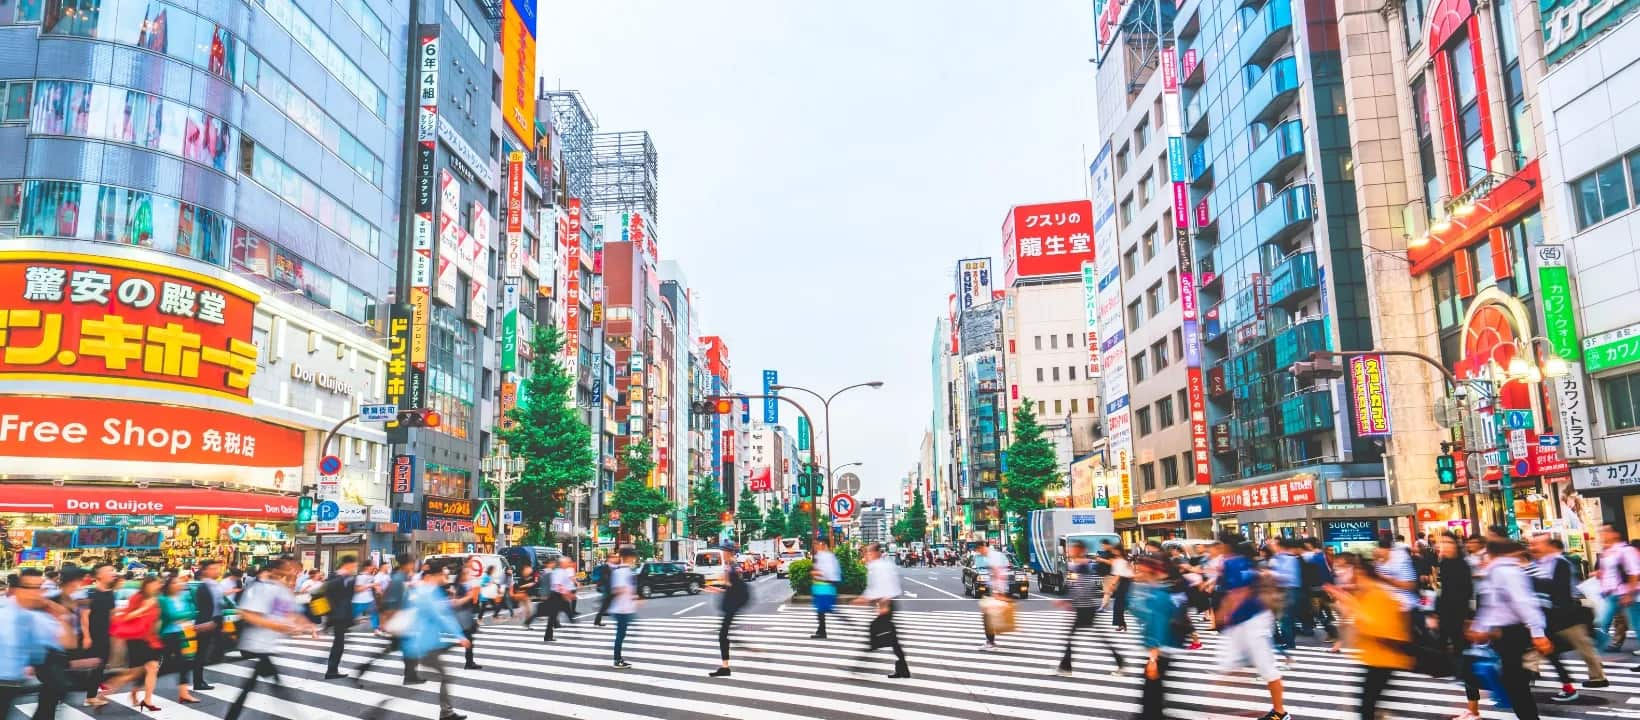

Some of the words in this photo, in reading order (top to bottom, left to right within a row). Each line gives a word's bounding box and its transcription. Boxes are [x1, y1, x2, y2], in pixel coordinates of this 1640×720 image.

[422, 44, 436, 100] 6年4組
[421, 150, 430, 205] ザ・ロックアップ
[570, 207, 579, 255] カラオケ
[1025, 212, 1081, 228] クスリの
[1020, 233, 1091, 257] 龍生堂
[24, 267, 226, 325] 驚安の殿堂
[568, 270, 577, 317] パセラ
[505, 328, 514, 352] レイク
[1551, 285, 1571, 358] カワノ・クォーク
[319, 372, 353, 394] Quijote
[1, 415, 88, 443] Free
[102, 418, 191, 453] Shop
[202, 429, 255, 456] 免税店
[1563, 379, 1585, 456] カワノ・トラスト
[66, 498, 99, 510] Don
[106, 498, 163, 512] Quijote
